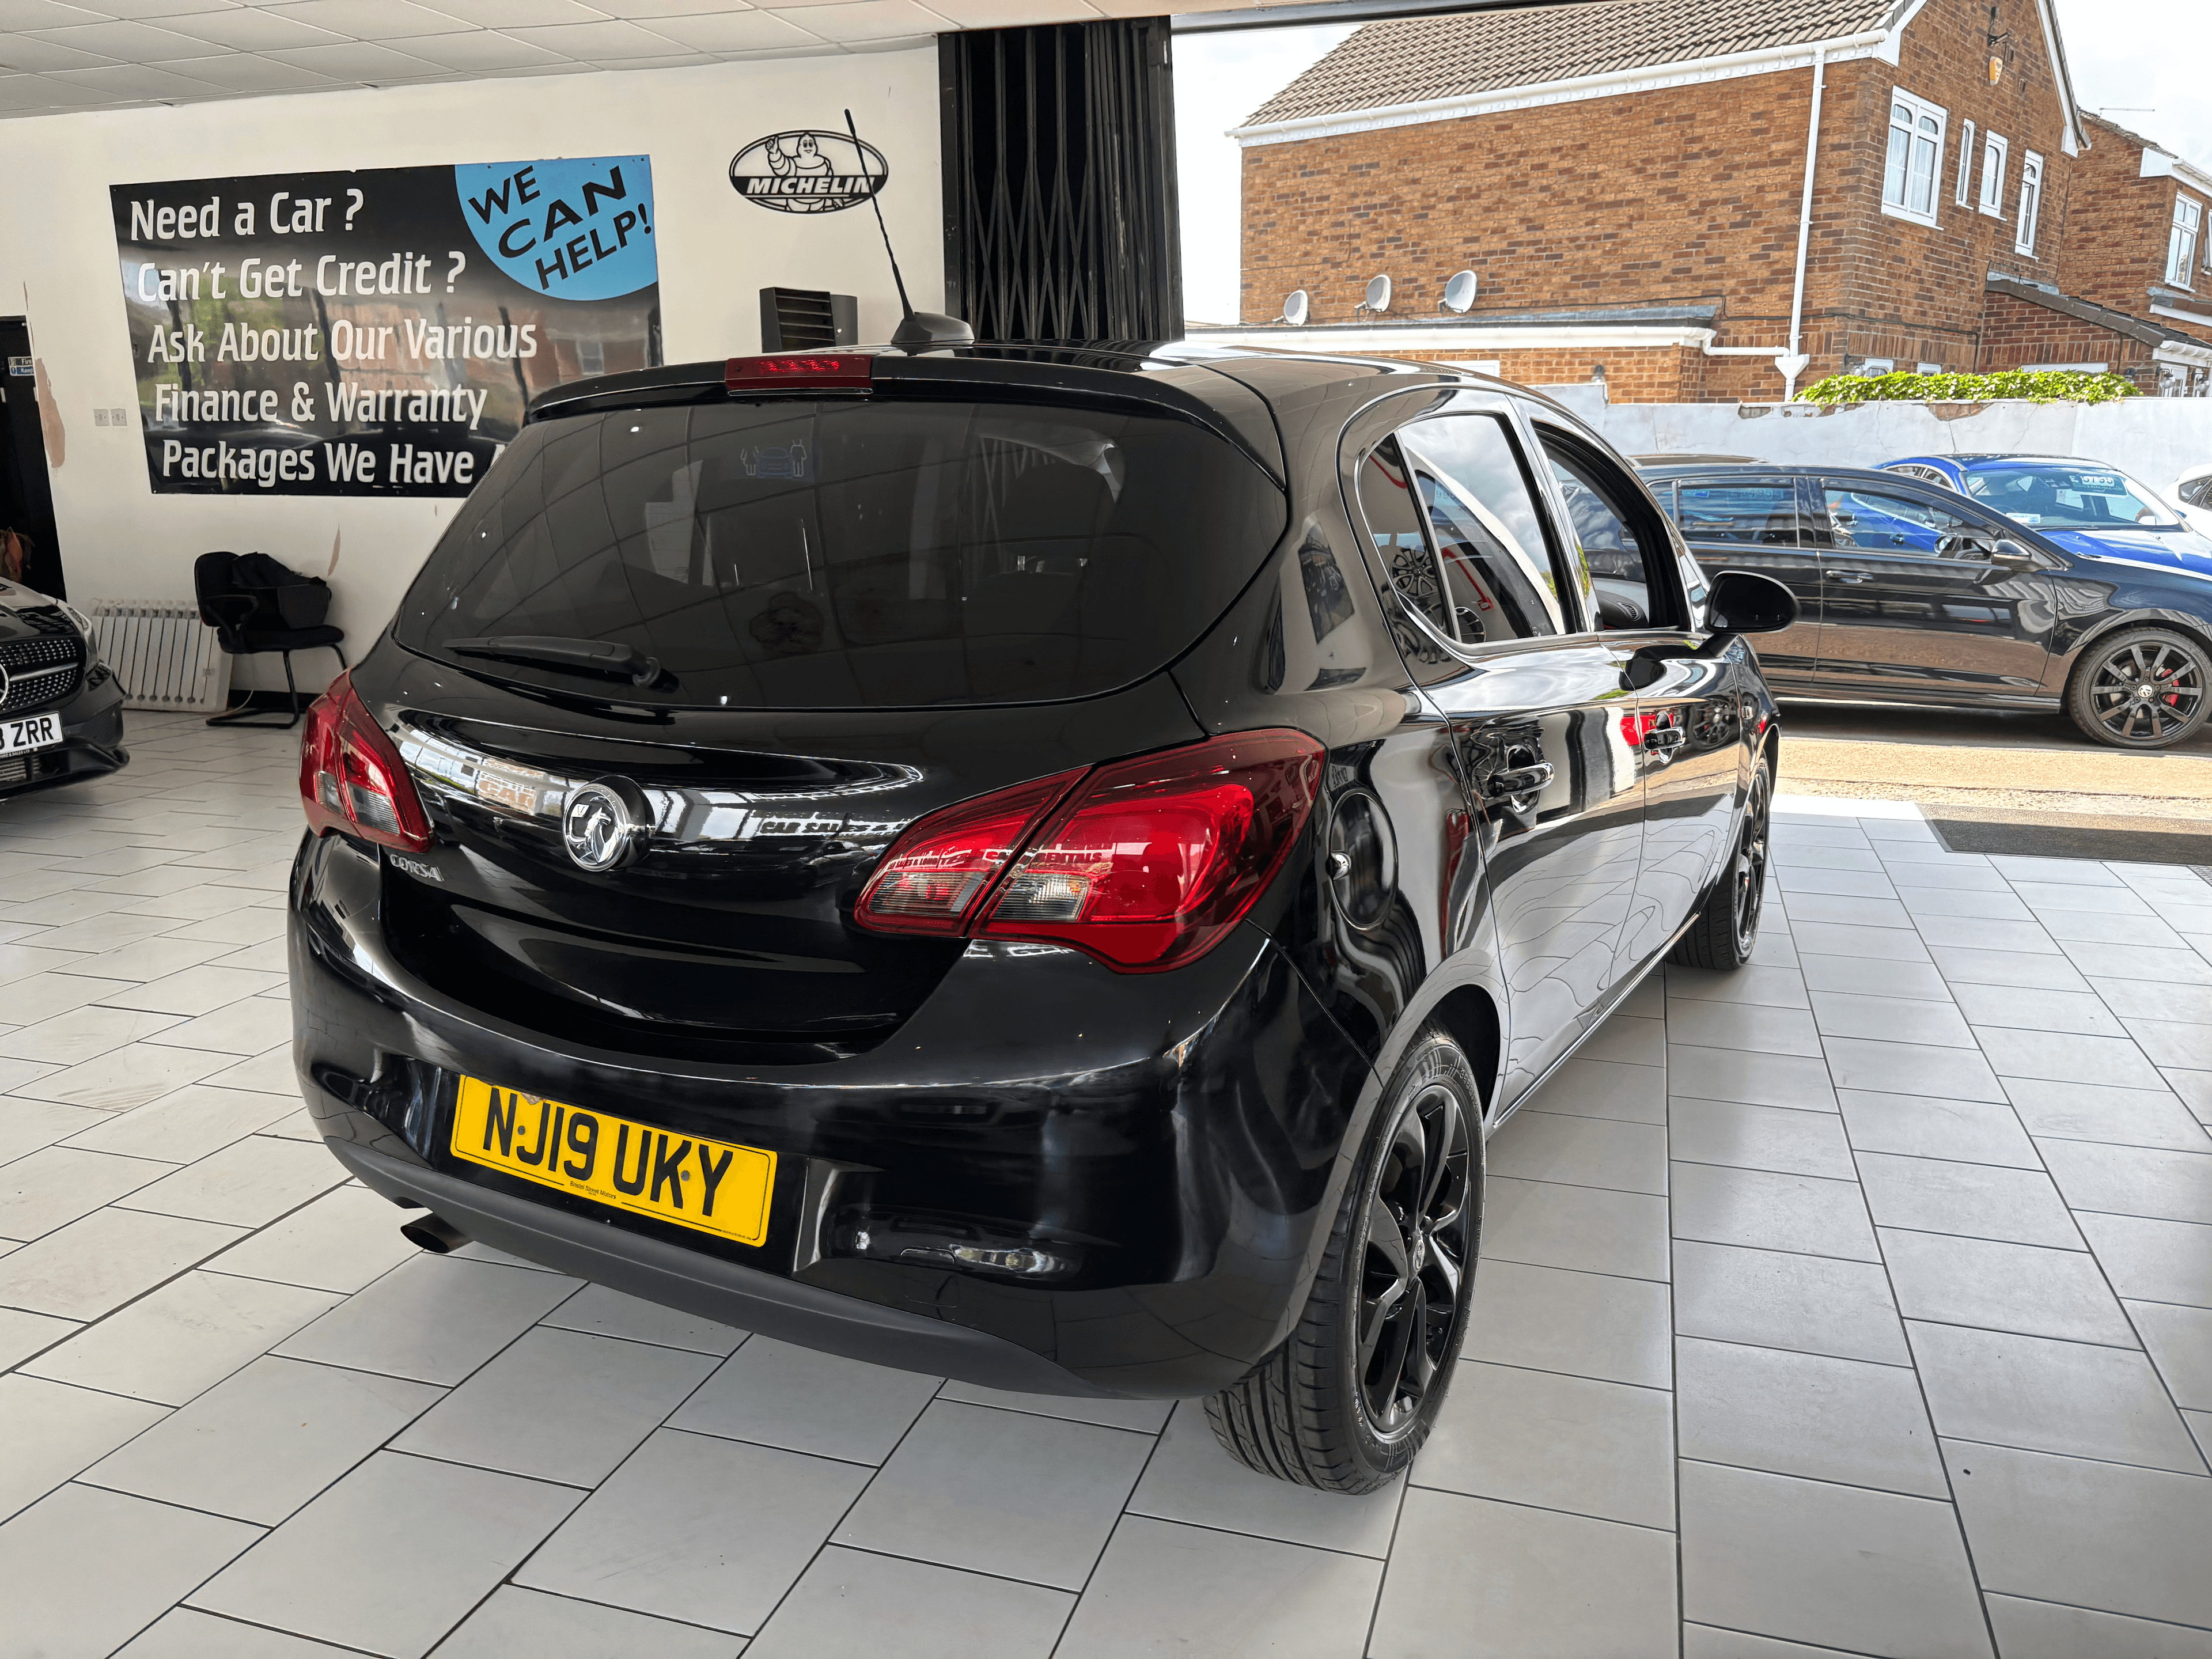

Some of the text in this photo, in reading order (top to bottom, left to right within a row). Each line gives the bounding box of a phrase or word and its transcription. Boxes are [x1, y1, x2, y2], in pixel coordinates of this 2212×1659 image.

[468, 165, 540, 224] WE
[746, 177, 876, 194] MICHELIN
[130, 188, 364, 241] Need a Car ?
[498, 165, 627, 258] CAN
[535, 203, 652, 290] HELP!
[138, 251, 466, 302] Can't Get Credit ?
[147, 317, 537, 363] Ask About Our Various
[156, 381, 488, 430] Finance & Warranty
[163, 440, 315, 487] Packages
[324, 442, 376, 483] We
[389, 444, 474, 484] Have
[10, 717, 54, 748] ZRR
[389, 854, 444, 882] CORSA
[483, 1086, 734, 1217] NJ19 UKY
[585, 1185, 599, 1194] Street
[600, 1190, 616, 1199] Motors
